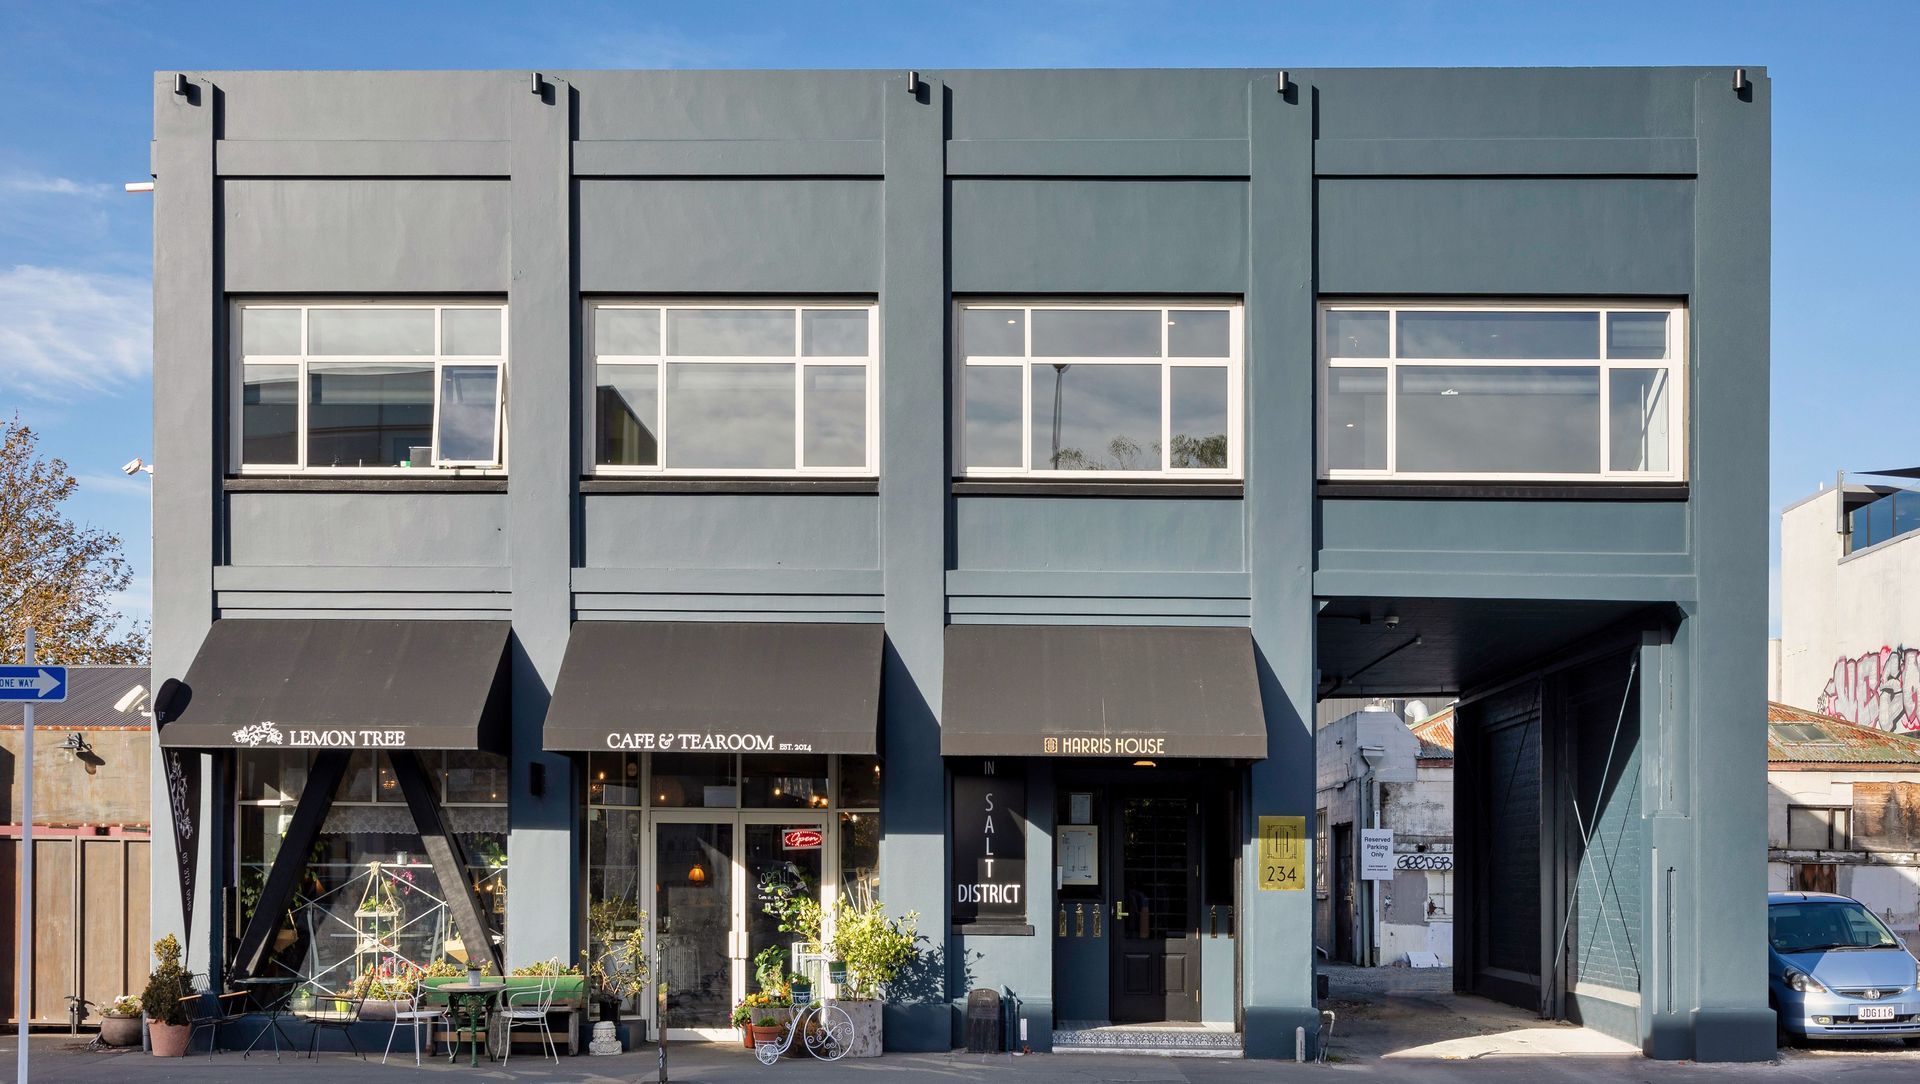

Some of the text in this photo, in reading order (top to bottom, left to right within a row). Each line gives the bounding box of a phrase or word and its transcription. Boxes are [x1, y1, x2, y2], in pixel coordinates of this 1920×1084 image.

[0, 678, 34, 688] ONE WAY
[289, 730, 406, 746] LEMON TREE
[606, 733, 775, 751] CAFE & TEAROOM
[1062, 737, 1165, 754] HARRIS HOUSE
[779, 743, 812, 752] EST. 2014
[984, 761, 995, 775] IN
[790, 832, 819, 847] Open
[1267, 866, 1297, 882] 234
[958, 884, 1021, 904] DISTRICT
[1860, 1008, 1894, 1018] JDG118
